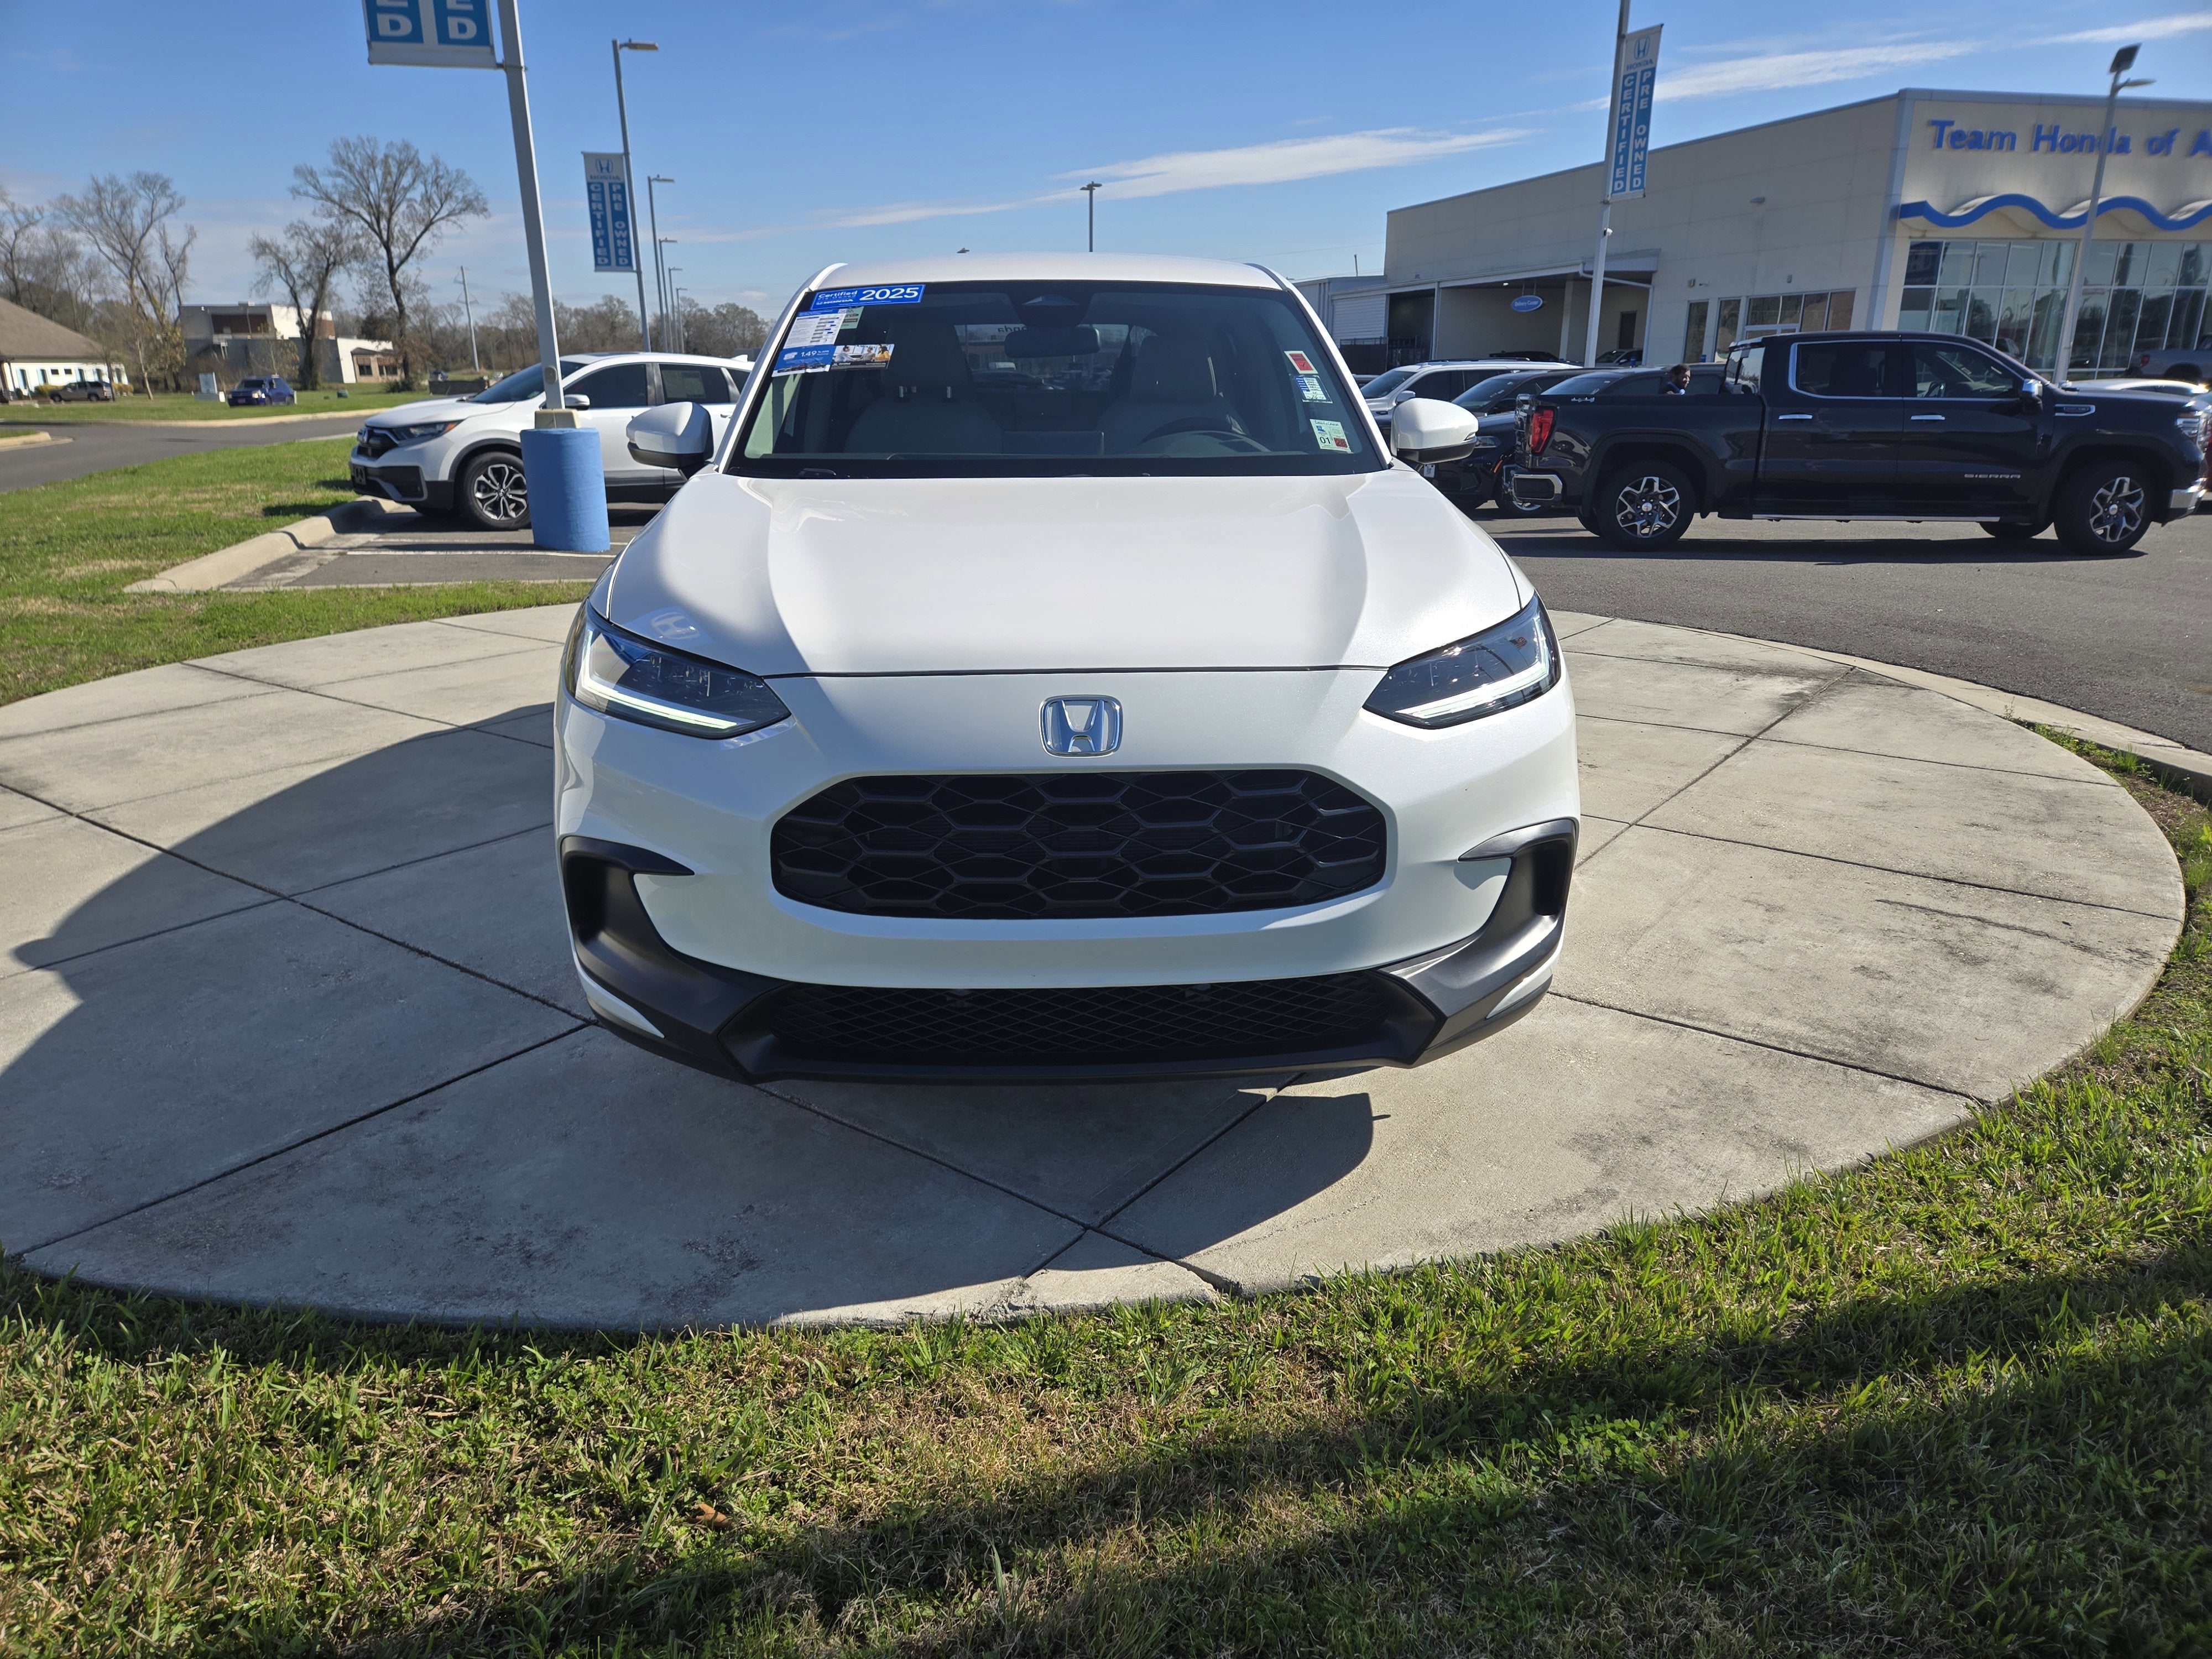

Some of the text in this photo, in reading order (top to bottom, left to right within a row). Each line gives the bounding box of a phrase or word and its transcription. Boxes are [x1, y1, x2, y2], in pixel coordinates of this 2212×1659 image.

[1626, 58, 1653, 71] HONDA
[1614, 75, 1635, 191] CERTIFIED
[1632, 70, 1652, 187] PRE OWNED
[1930, 119, 2017, 151] Team
[2033, 123, 2132, 154] Honda
[2147, 127, 2180, 156] of
[589, 184, 609, 265] CERTIFIED
[612, 184, 629, 265] PRE OWNED
[818, 290, 858, 299] Certified
[859, 287, 919, 301] 2025
